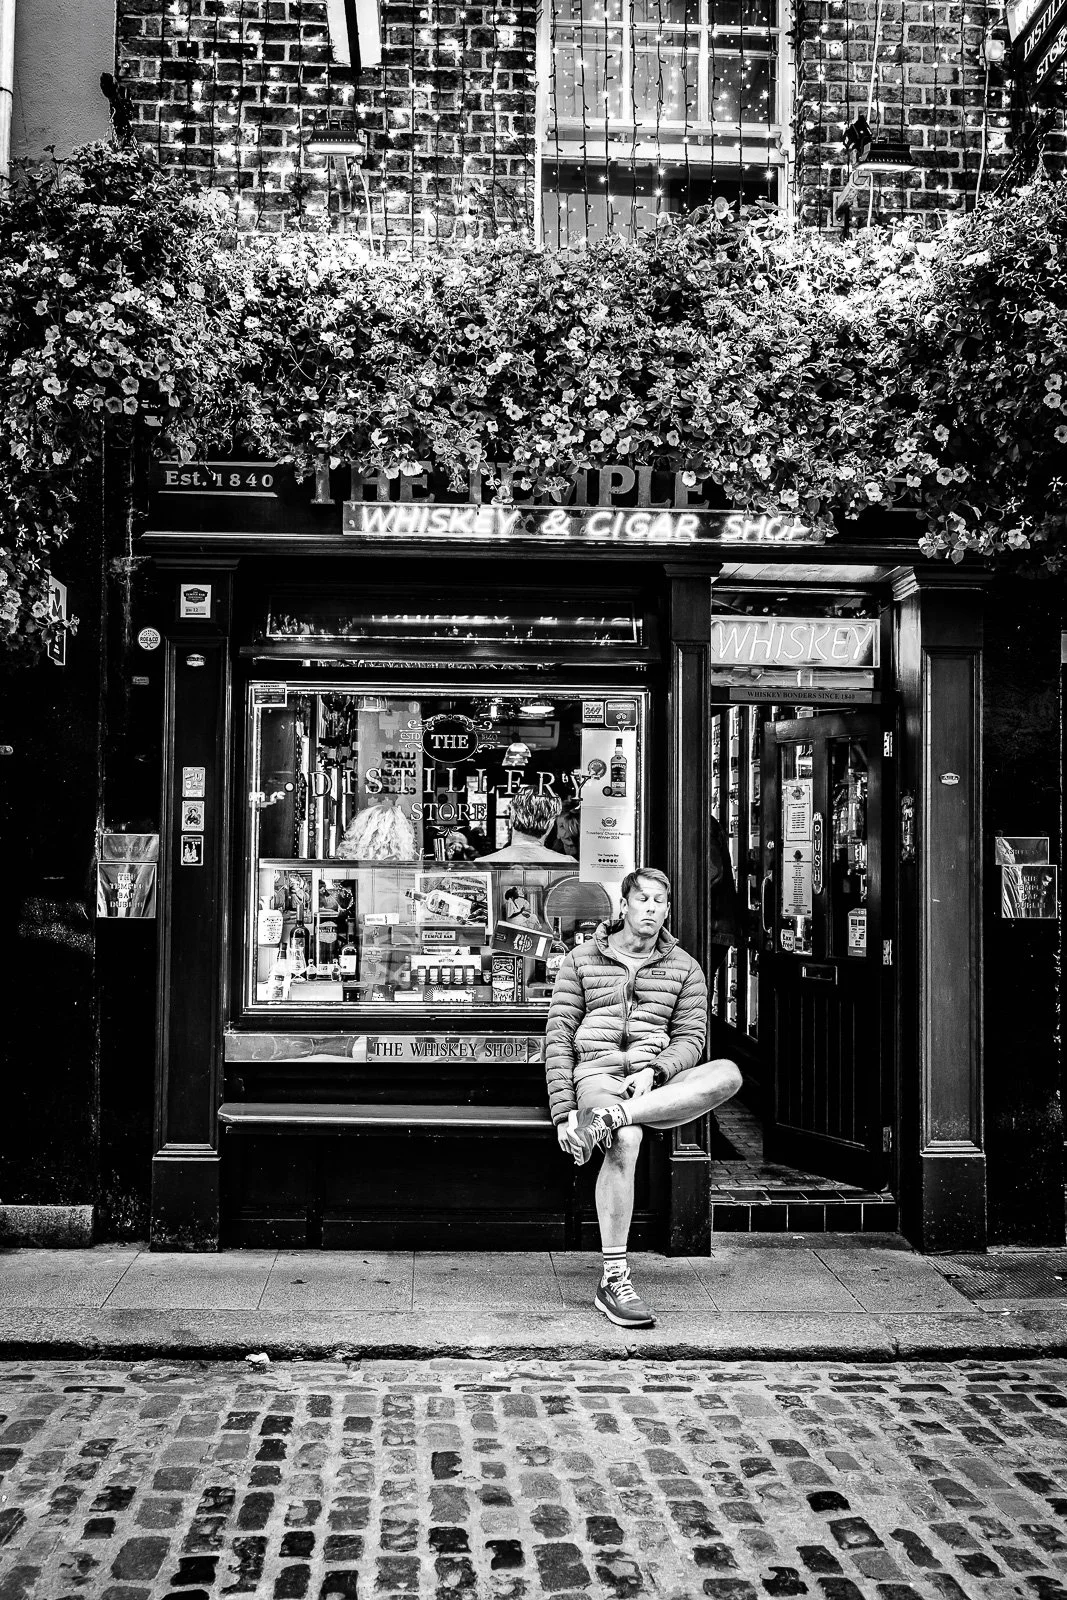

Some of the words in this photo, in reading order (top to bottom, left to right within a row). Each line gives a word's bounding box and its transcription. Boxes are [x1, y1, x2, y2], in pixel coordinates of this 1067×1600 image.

[165, 470, 207, 486] Est.
[215, 473, 274, 487] 1840
[361, 506, 521, 534] WHISKEY
[541, 510, 571, 536] &
[586, 512, 700, 540] CIGAR
[717, 622, 874, 661] WHISKEY
[430, 734, 469, 749] THE
[309, 767, 592, 802] DISTILLERY
[410, 802, 488, 821] STORE
[373, 1042, 404, 1057] THE
[410, 1042, 477, 1057] WHISKEY
[485, 1042, 524, 1057] SHOP
